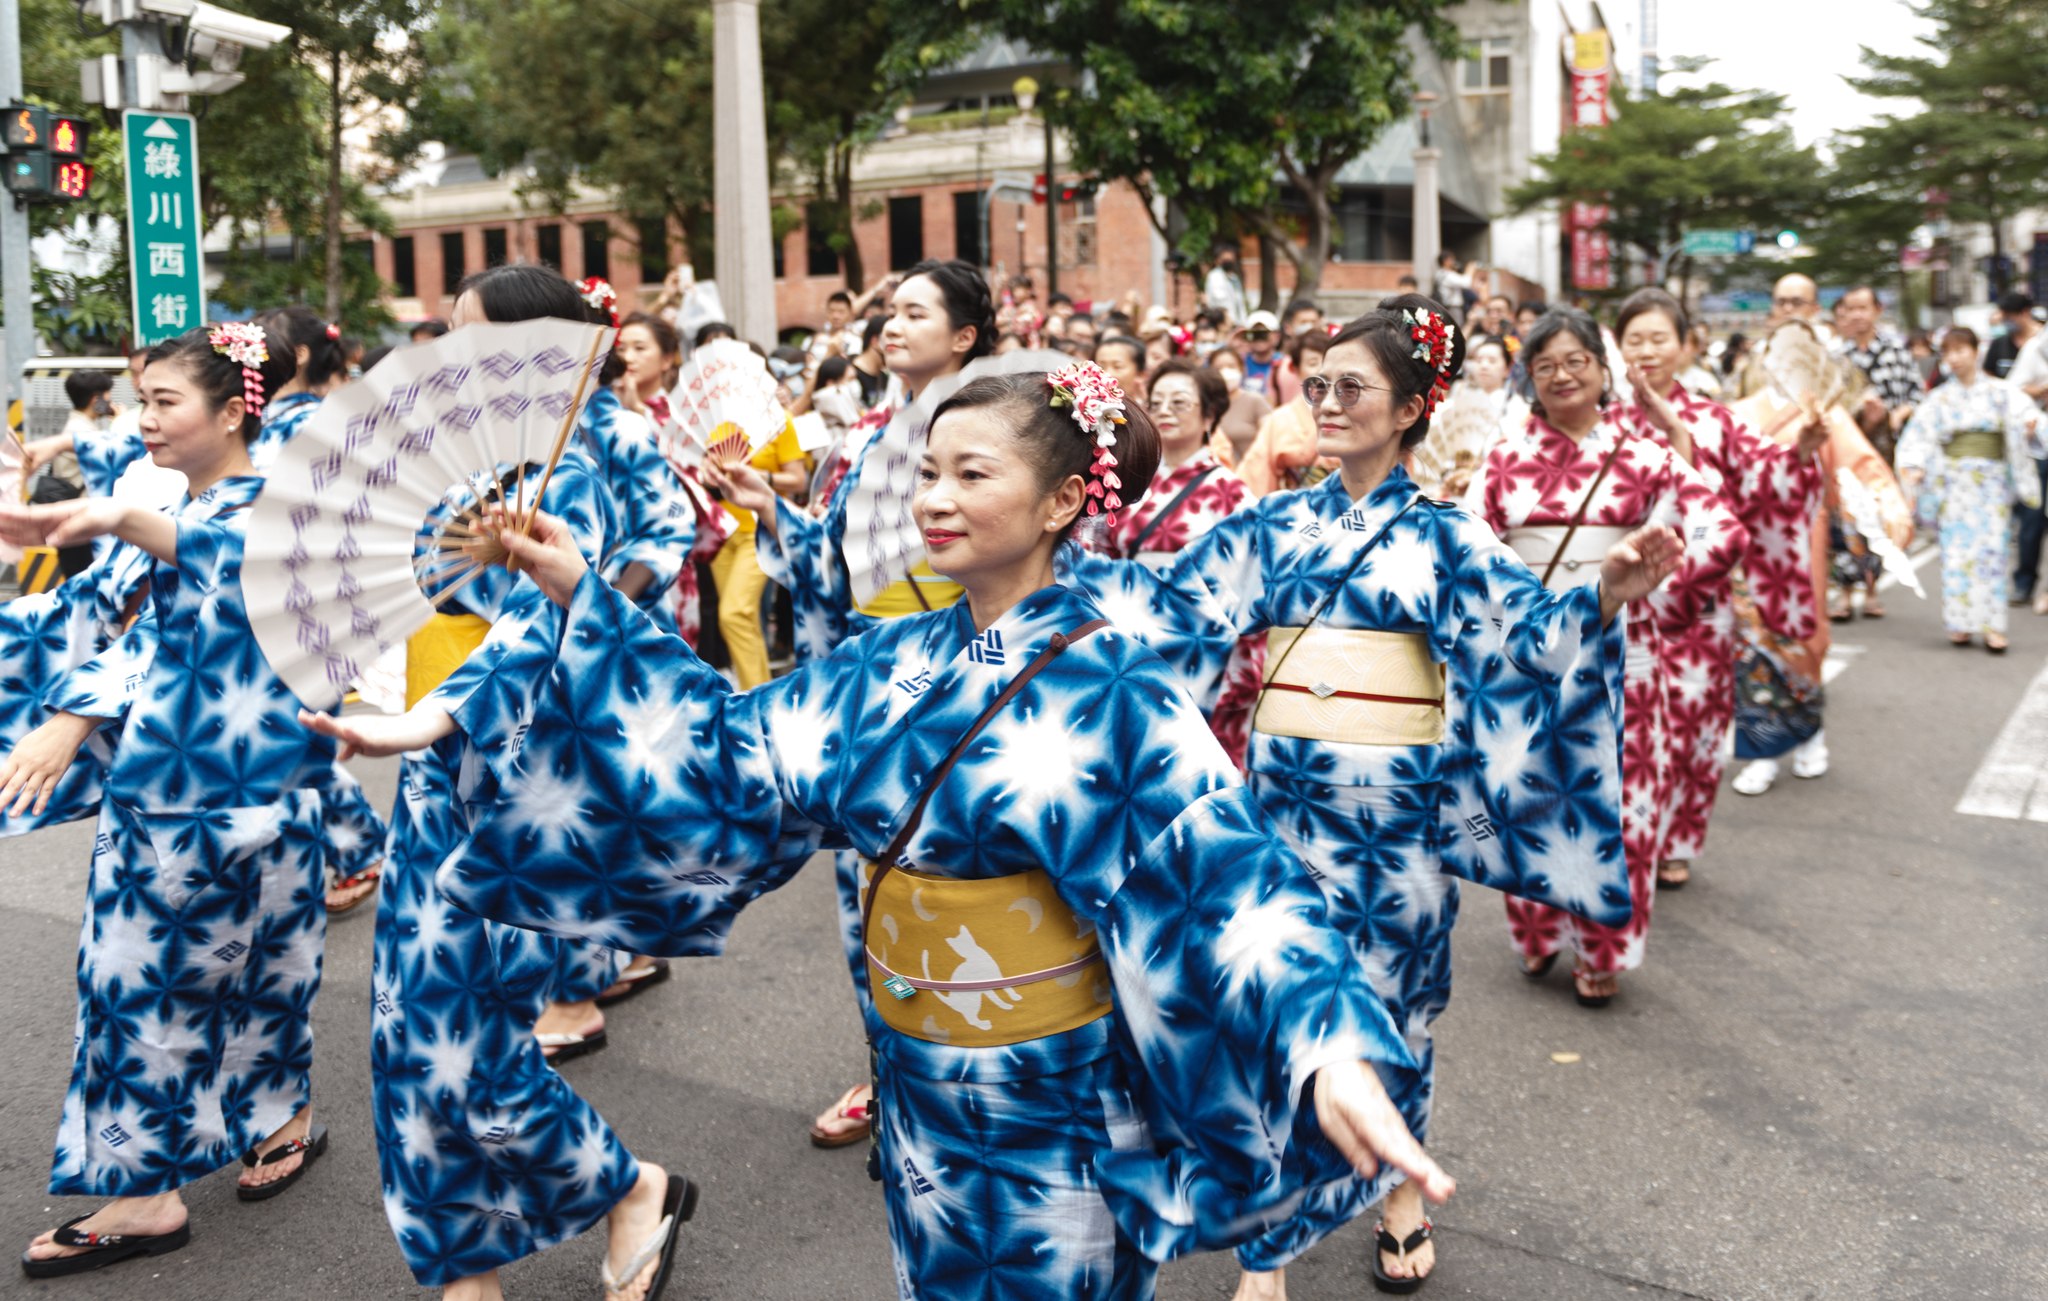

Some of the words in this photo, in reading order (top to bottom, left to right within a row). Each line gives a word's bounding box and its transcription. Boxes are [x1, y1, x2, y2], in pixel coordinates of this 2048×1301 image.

[61, 163, 85, 196] 13
[144, 141, 188, 328] 綠川西街
